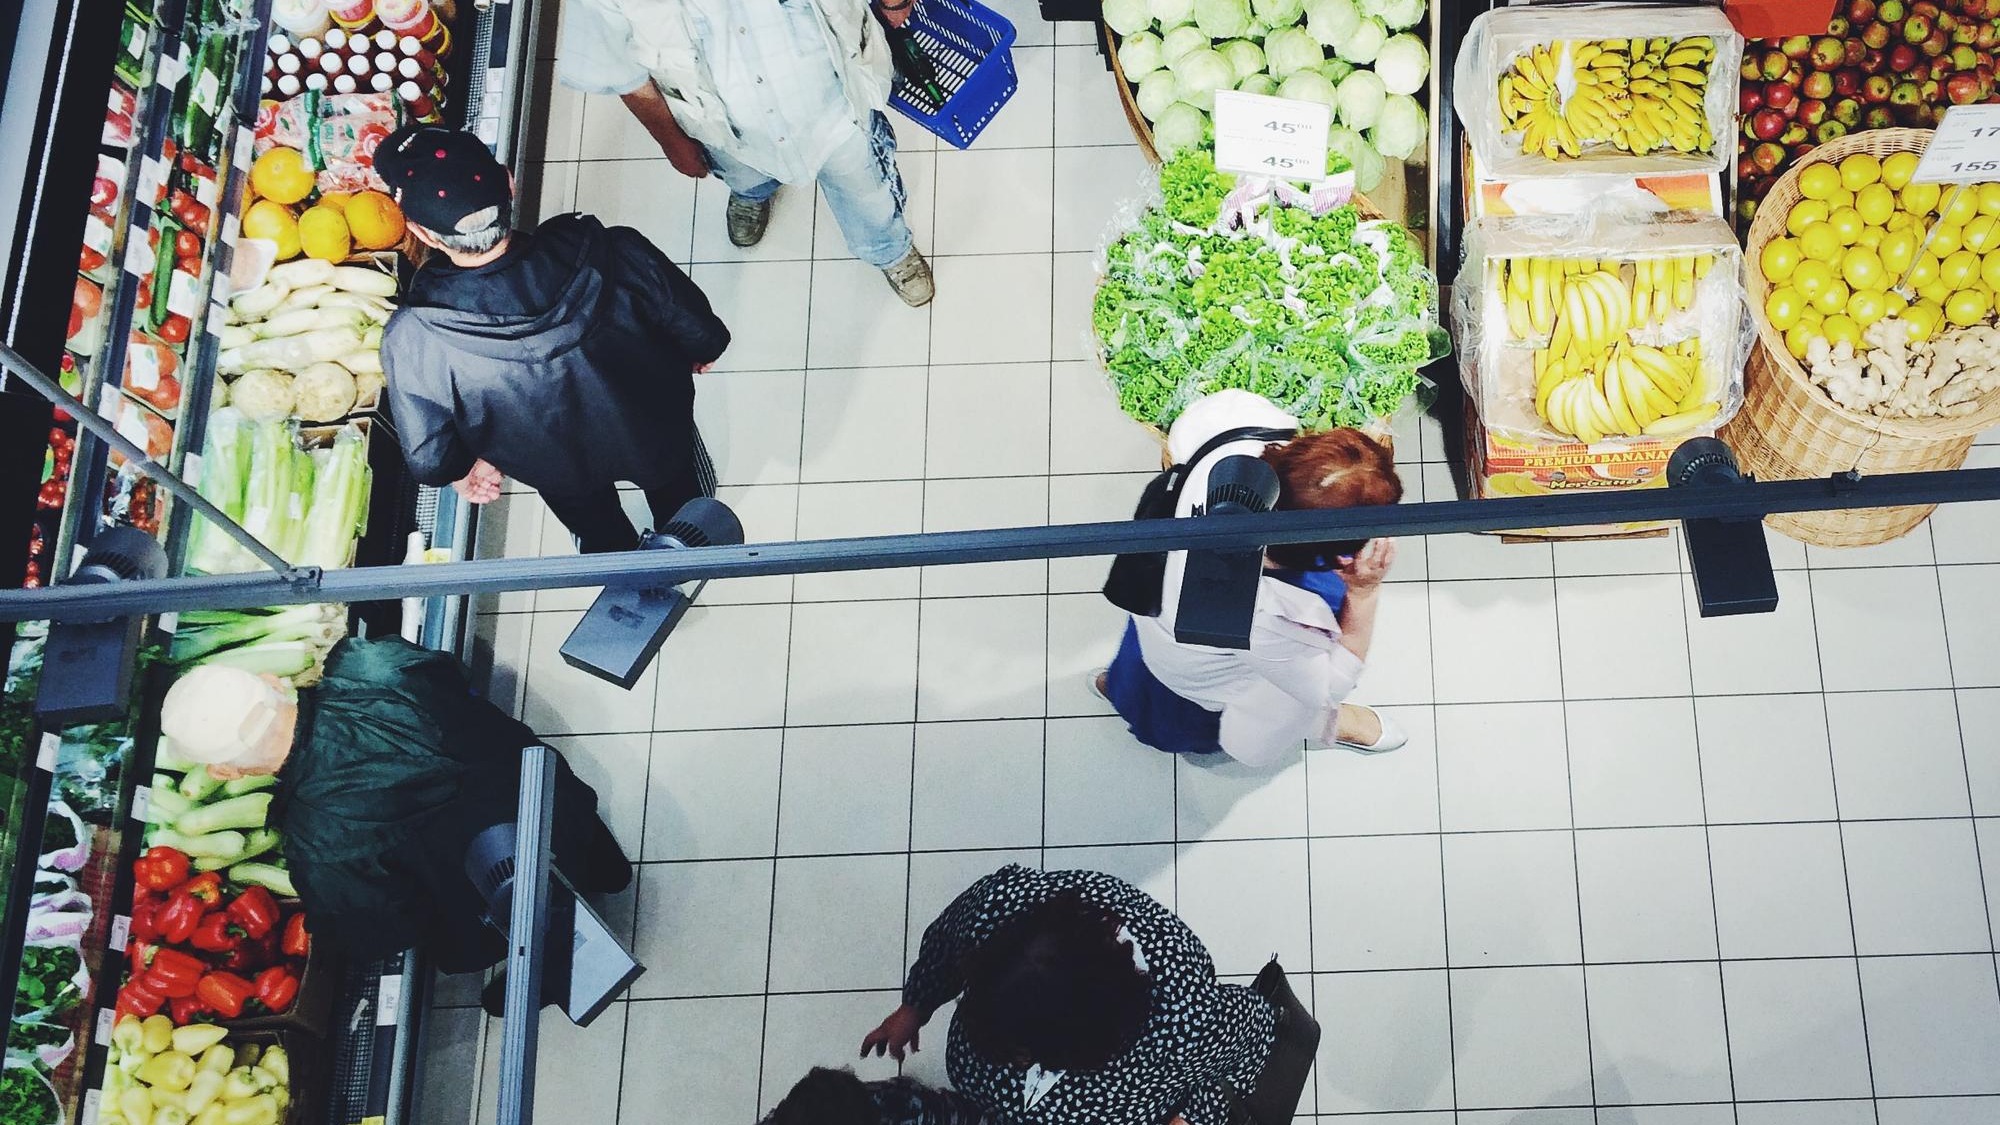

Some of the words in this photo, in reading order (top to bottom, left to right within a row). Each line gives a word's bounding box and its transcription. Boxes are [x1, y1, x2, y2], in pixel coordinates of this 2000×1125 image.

[1951, 160, 2000, 173] 155
[1523, 453, 1597, 467] PREMIUM
[1600, 449, 1675, 464] BANANA
